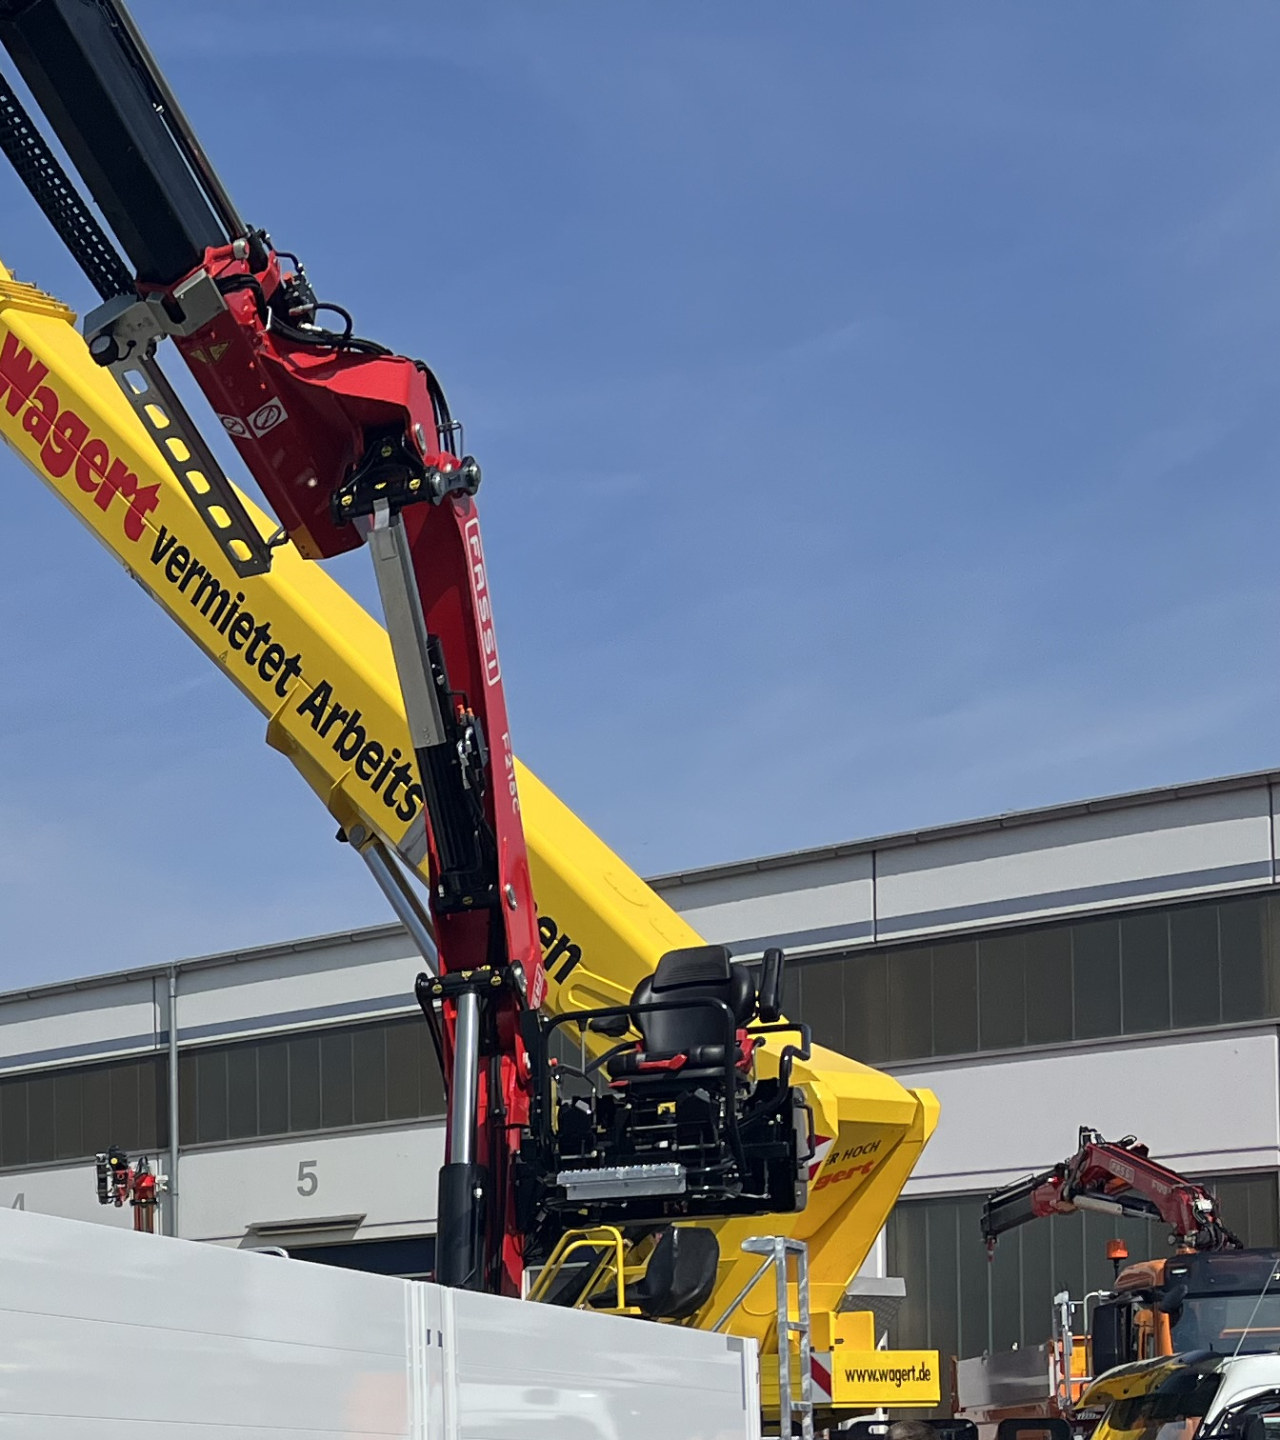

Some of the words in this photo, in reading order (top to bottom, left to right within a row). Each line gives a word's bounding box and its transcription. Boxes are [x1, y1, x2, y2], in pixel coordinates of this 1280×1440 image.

[150, 524, 303, 700] vermietet
[470, 534, 497, 670] FASSI
[841, 1139, 882, 1162] HOCH
[296, 1160, 319, 1197] 5
[844, 1361, 931, 1388] www.wagert.de
